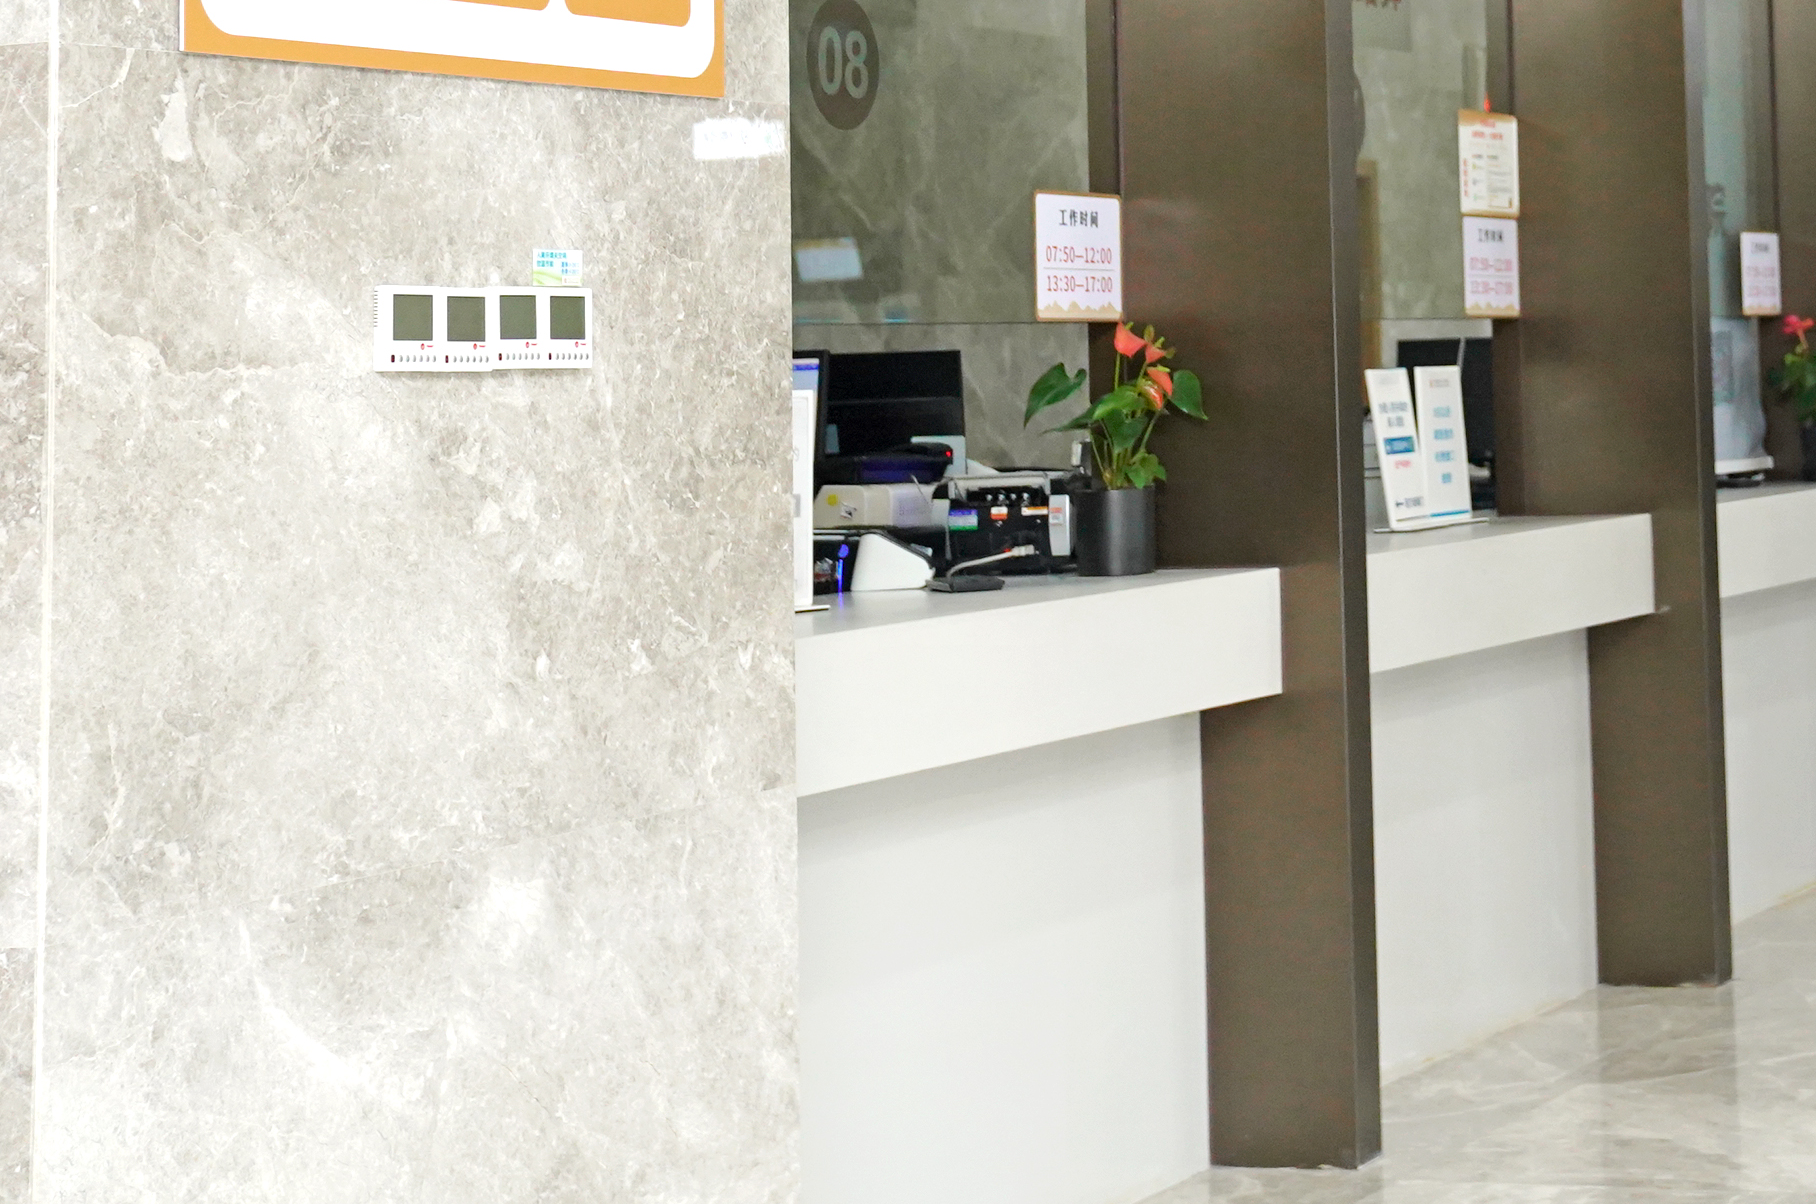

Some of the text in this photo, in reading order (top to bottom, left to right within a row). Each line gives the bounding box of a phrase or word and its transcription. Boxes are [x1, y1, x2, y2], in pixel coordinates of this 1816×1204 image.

[817, 25, 870, 100] 08
[1059, 209, 1099, 228] 工作时间
